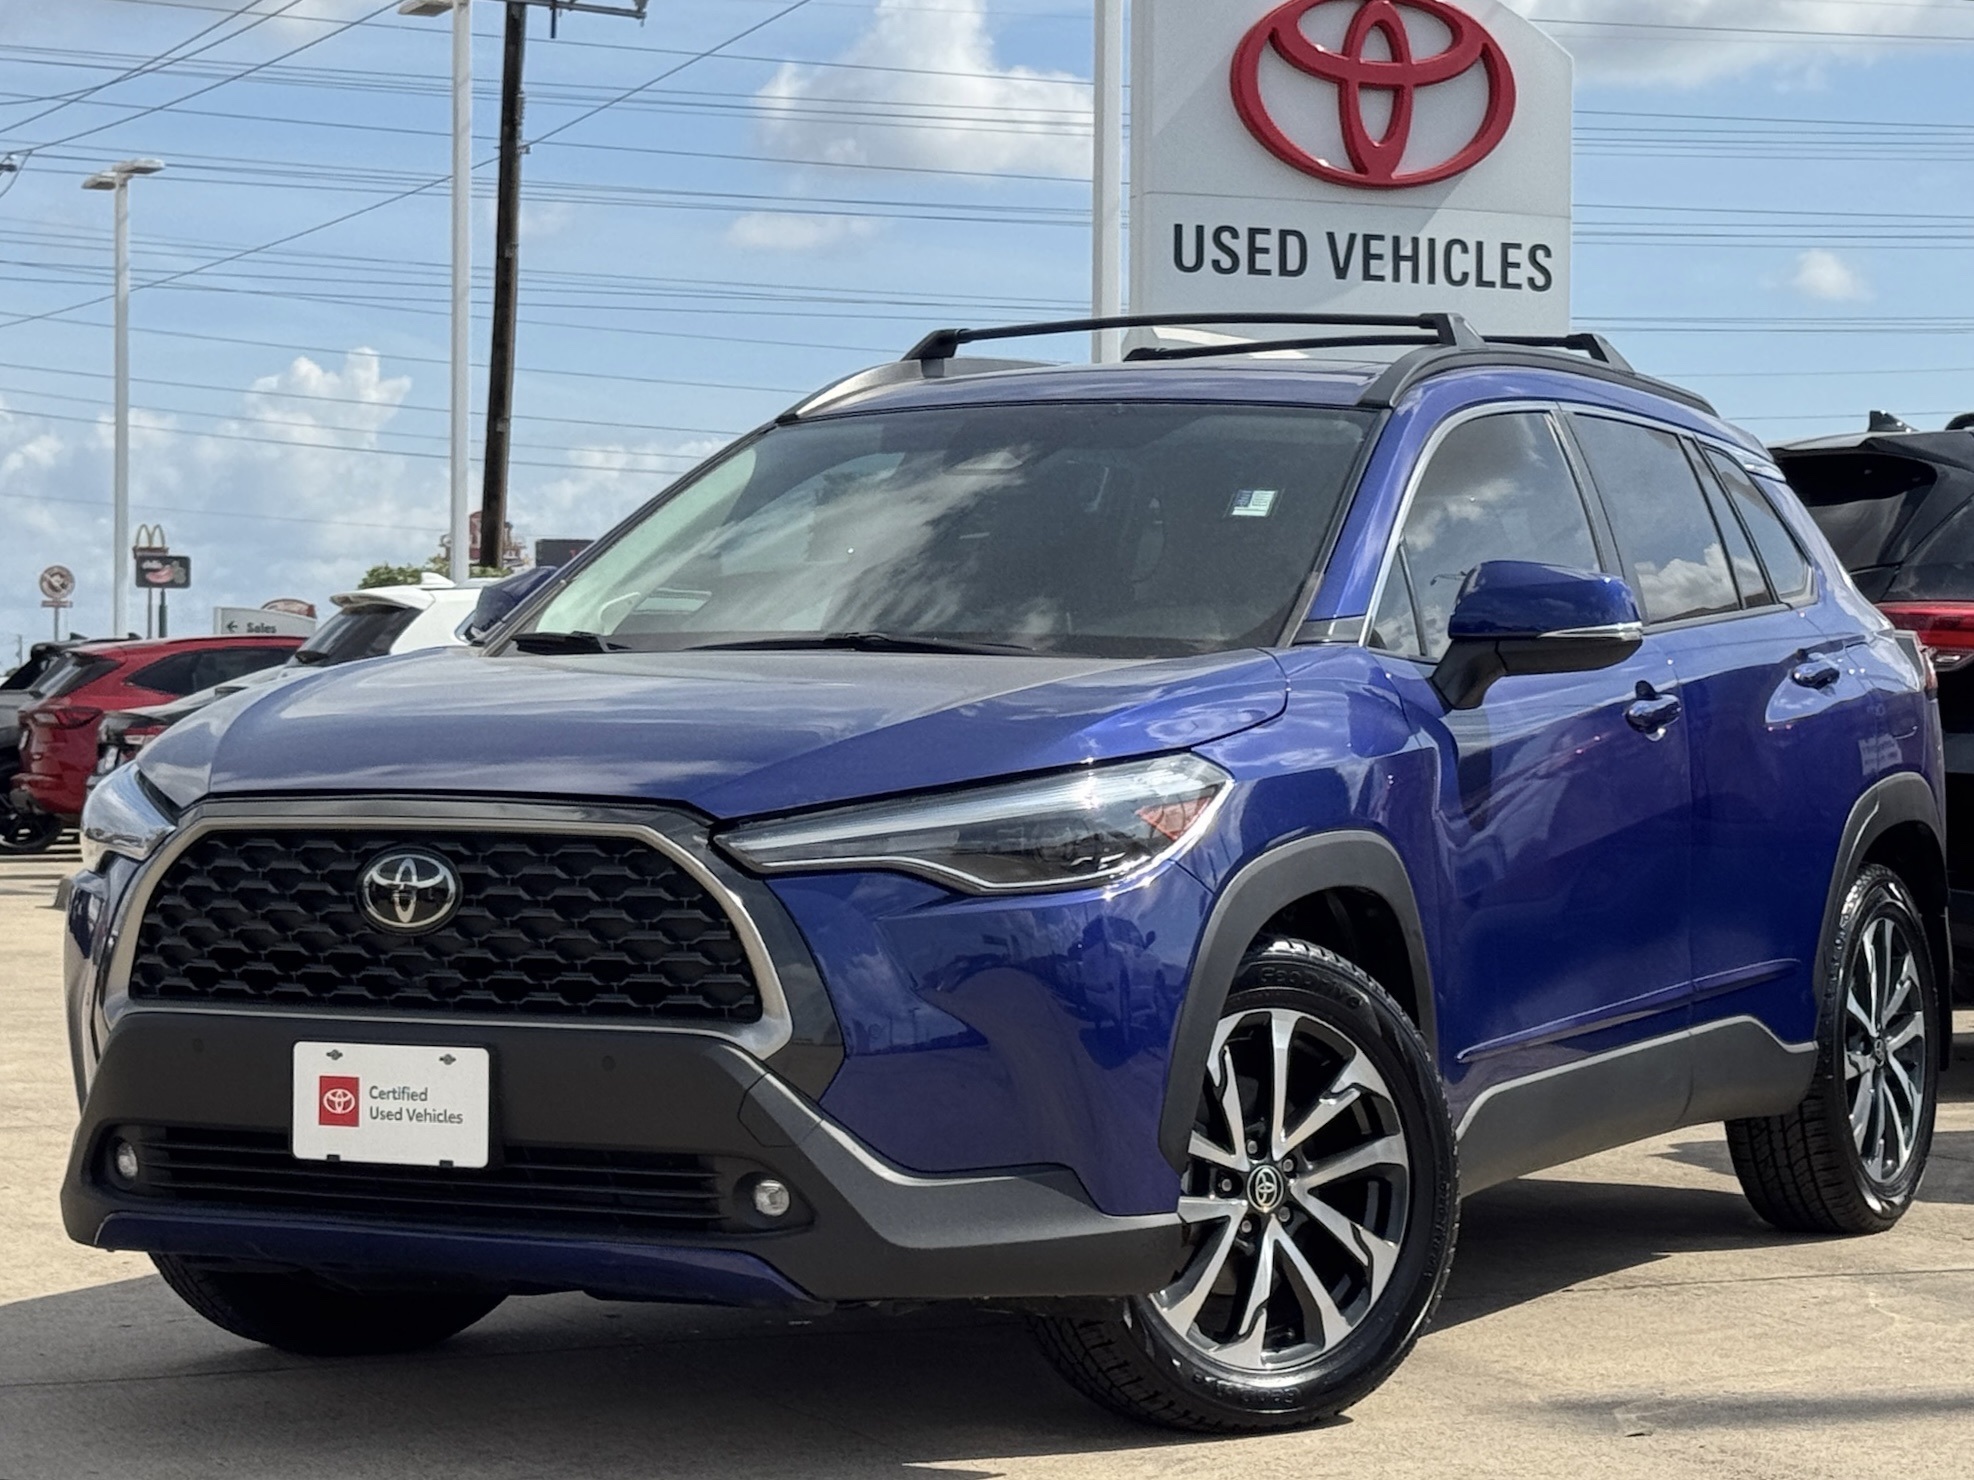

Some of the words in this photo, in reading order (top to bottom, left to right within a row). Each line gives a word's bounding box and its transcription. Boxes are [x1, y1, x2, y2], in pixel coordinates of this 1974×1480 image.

[1173, 223, 1308, 278] USED
[1325, 231, 1552, 292] VEHICLES
[246, 622, 277, 634] Sales
[369, 1085, 428, 1102] Certified
[369, 1106, 403, 1121] Used
[406, 1108, 464, 1124] Vehicles
